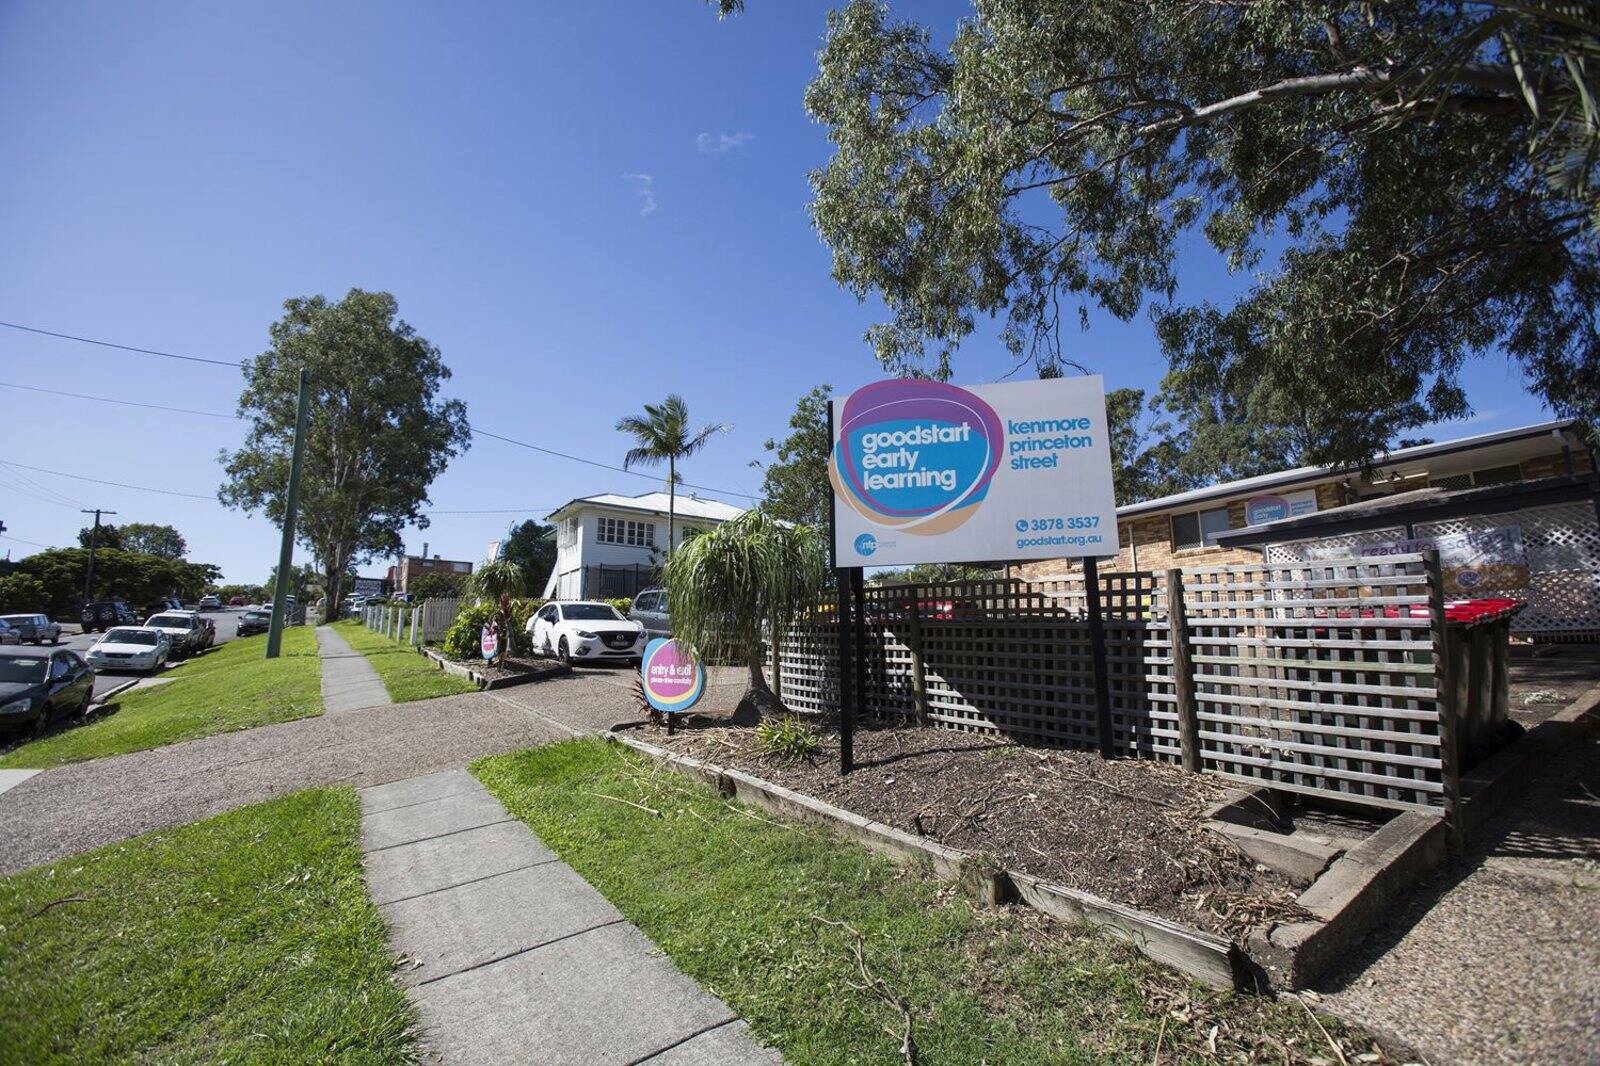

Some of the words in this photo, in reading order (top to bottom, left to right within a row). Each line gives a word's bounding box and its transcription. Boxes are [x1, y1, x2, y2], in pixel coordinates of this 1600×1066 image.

[1008, 417, 1091, 435] kenmore
[862, 422, 971, 453] goodstart
[1009, 434, 1092, 456] princeton
[862, 448, 919, 470] early
[1011, 453, 1058, 470] street
[864, 467, 957, 491] learning
[1031, 518, 1064, 531] 3878
[1067, 516, 1100, 529] 3537
[1016, 535, 1102, 549] goodstart.org.au
[651, 664, 670, 677] entry
[670, 664, 676, 676] &
